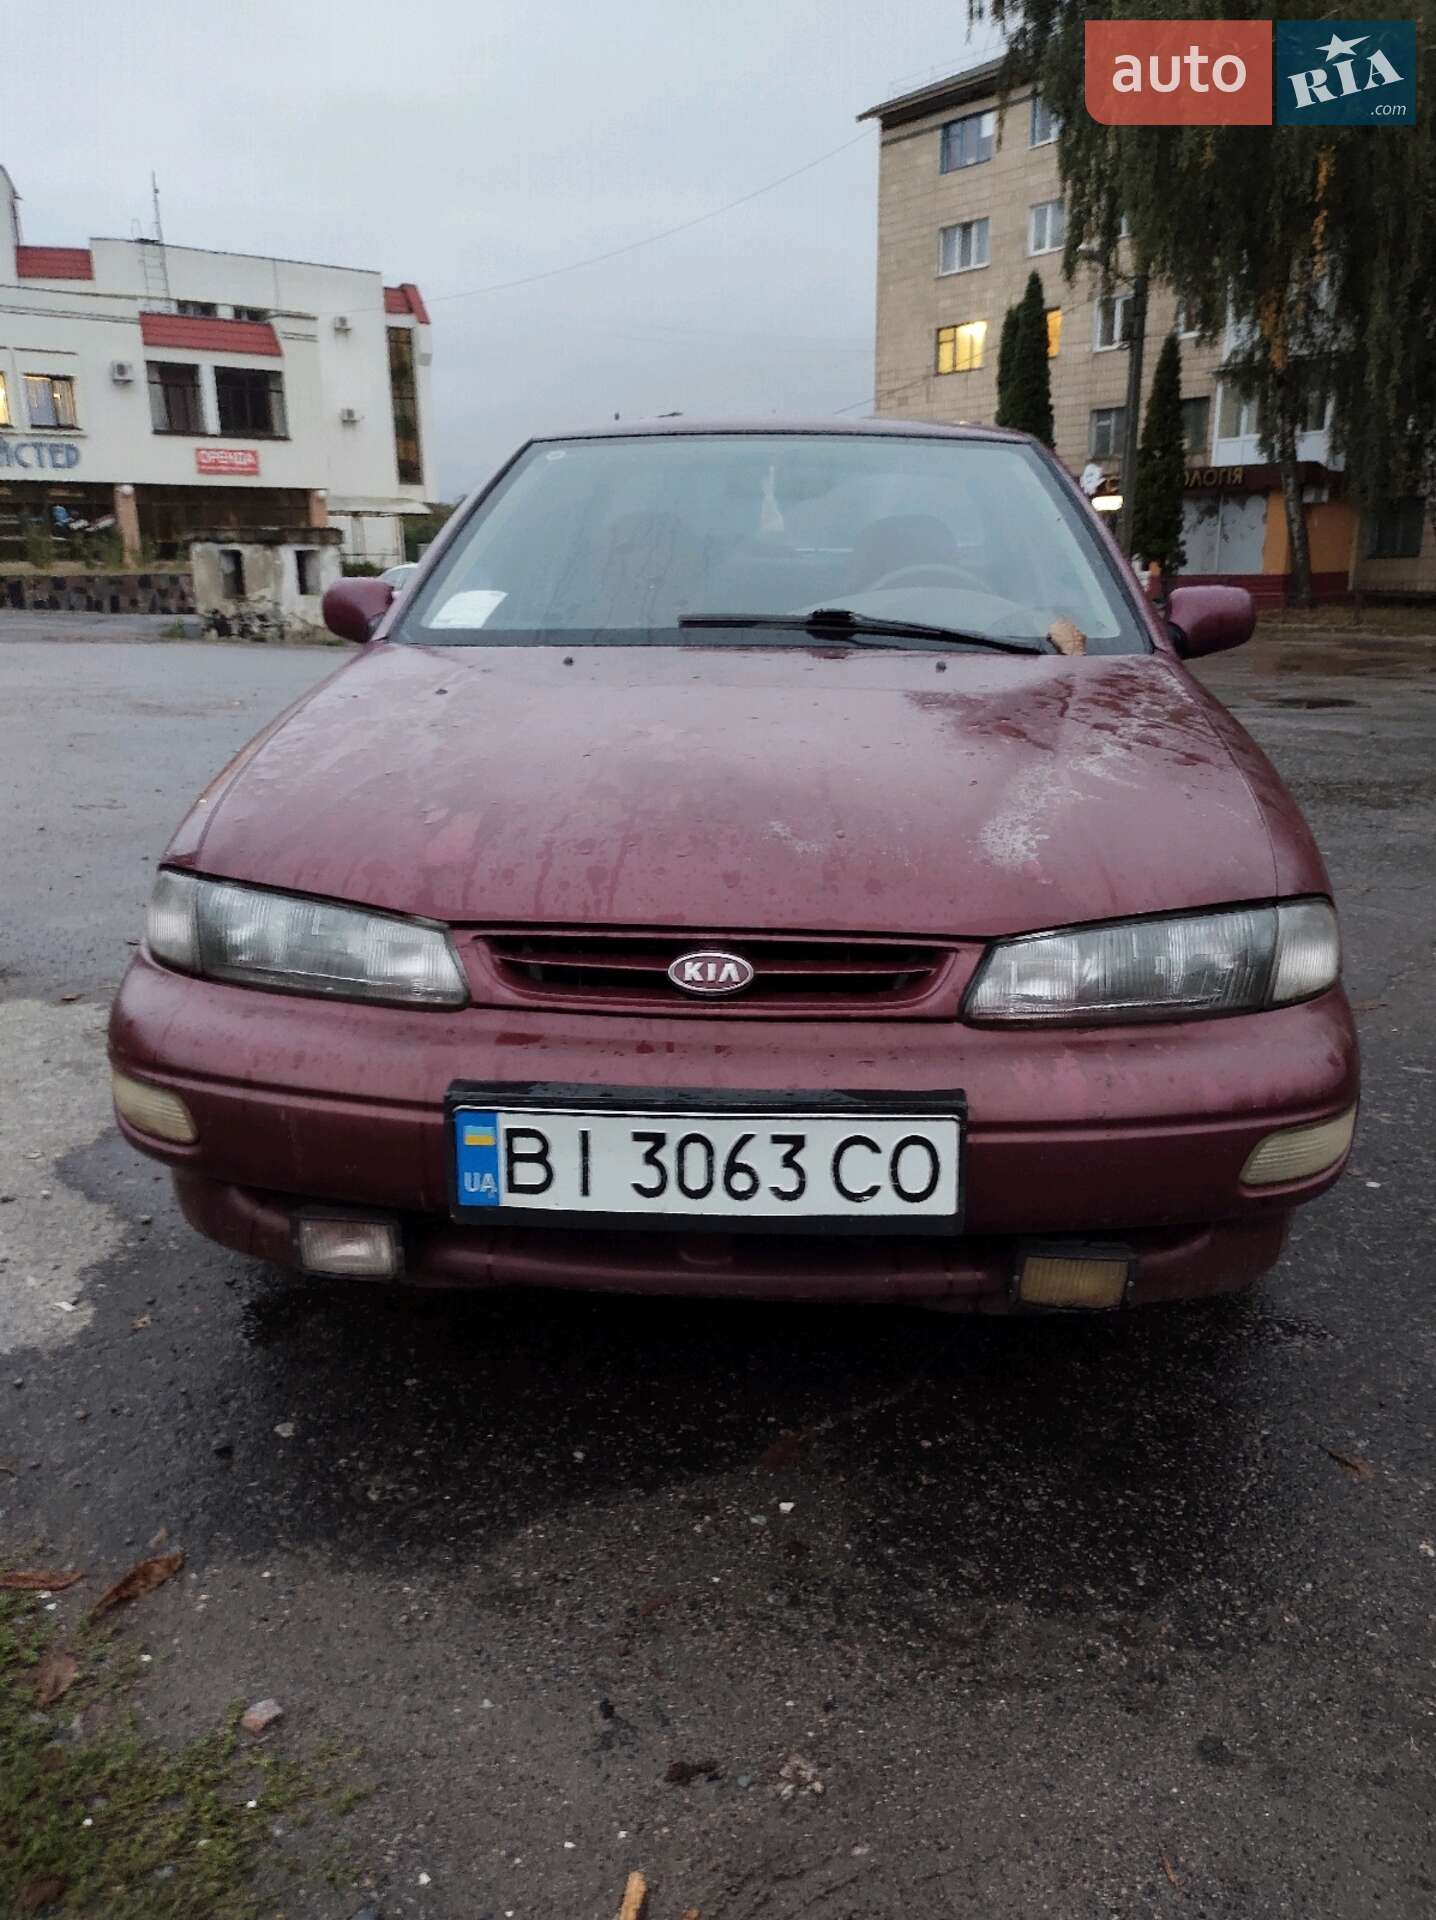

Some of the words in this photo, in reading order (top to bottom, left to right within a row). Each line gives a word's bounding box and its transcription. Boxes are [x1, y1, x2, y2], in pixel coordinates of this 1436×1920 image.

[684, 961, 740, 982] KIA
[506, 1127, 592, 1197] BI
[631, 1132, 807, 1201] 3063
[833, 1134, 940, 1203] CO
[463, 1171, 497, 1193] UA
